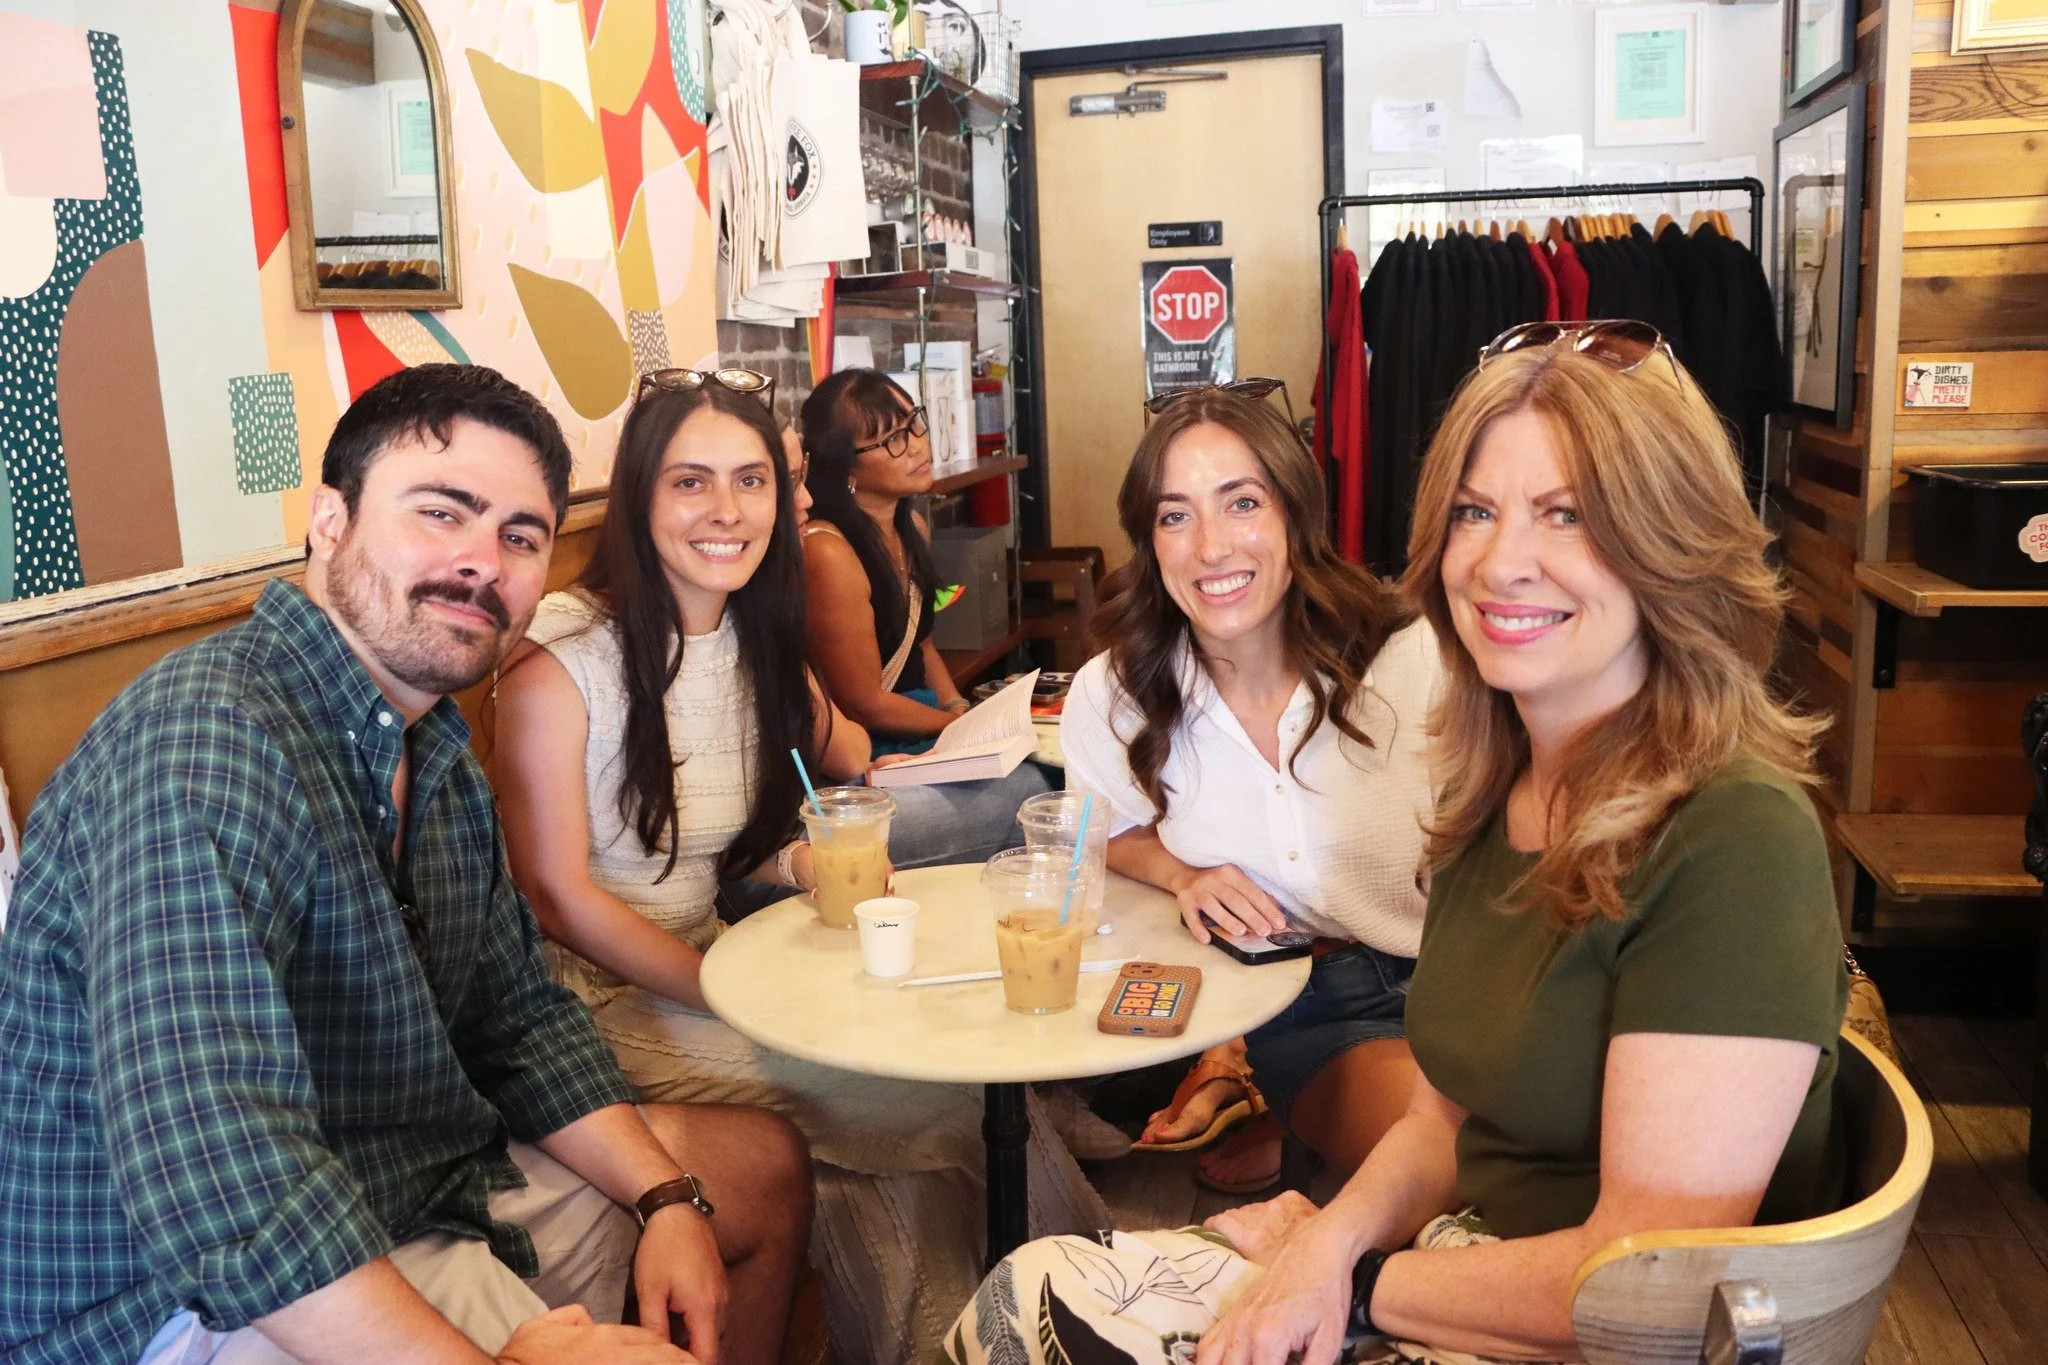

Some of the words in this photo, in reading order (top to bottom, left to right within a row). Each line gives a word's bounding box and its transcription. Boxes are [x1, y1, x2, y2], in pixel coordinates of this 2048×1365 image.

[801, 135, 816, 159] FOX
[1150, 229, 1191, 238] Employees
[1150, 238, 1168, 246] Only
[1157, 291, 1220, 321] STOP
[1153, 351, 1173, 361] THIS
[1174, 351, 1182, 361] IS
[1184, 351, 1200, 360] NOT
[1202, 350, 1208, 359] A
[1935, 365, 1963, 375] DIRTY
[1932, 384, 1969, 394] PRETTY
[1932, 394, 1967, 404] PLEASE
[2030, 533, 2048, 543] CO
[1120, 982, 1159, 1009] BIG
[1152, 1000, 1174, 1010] GO
